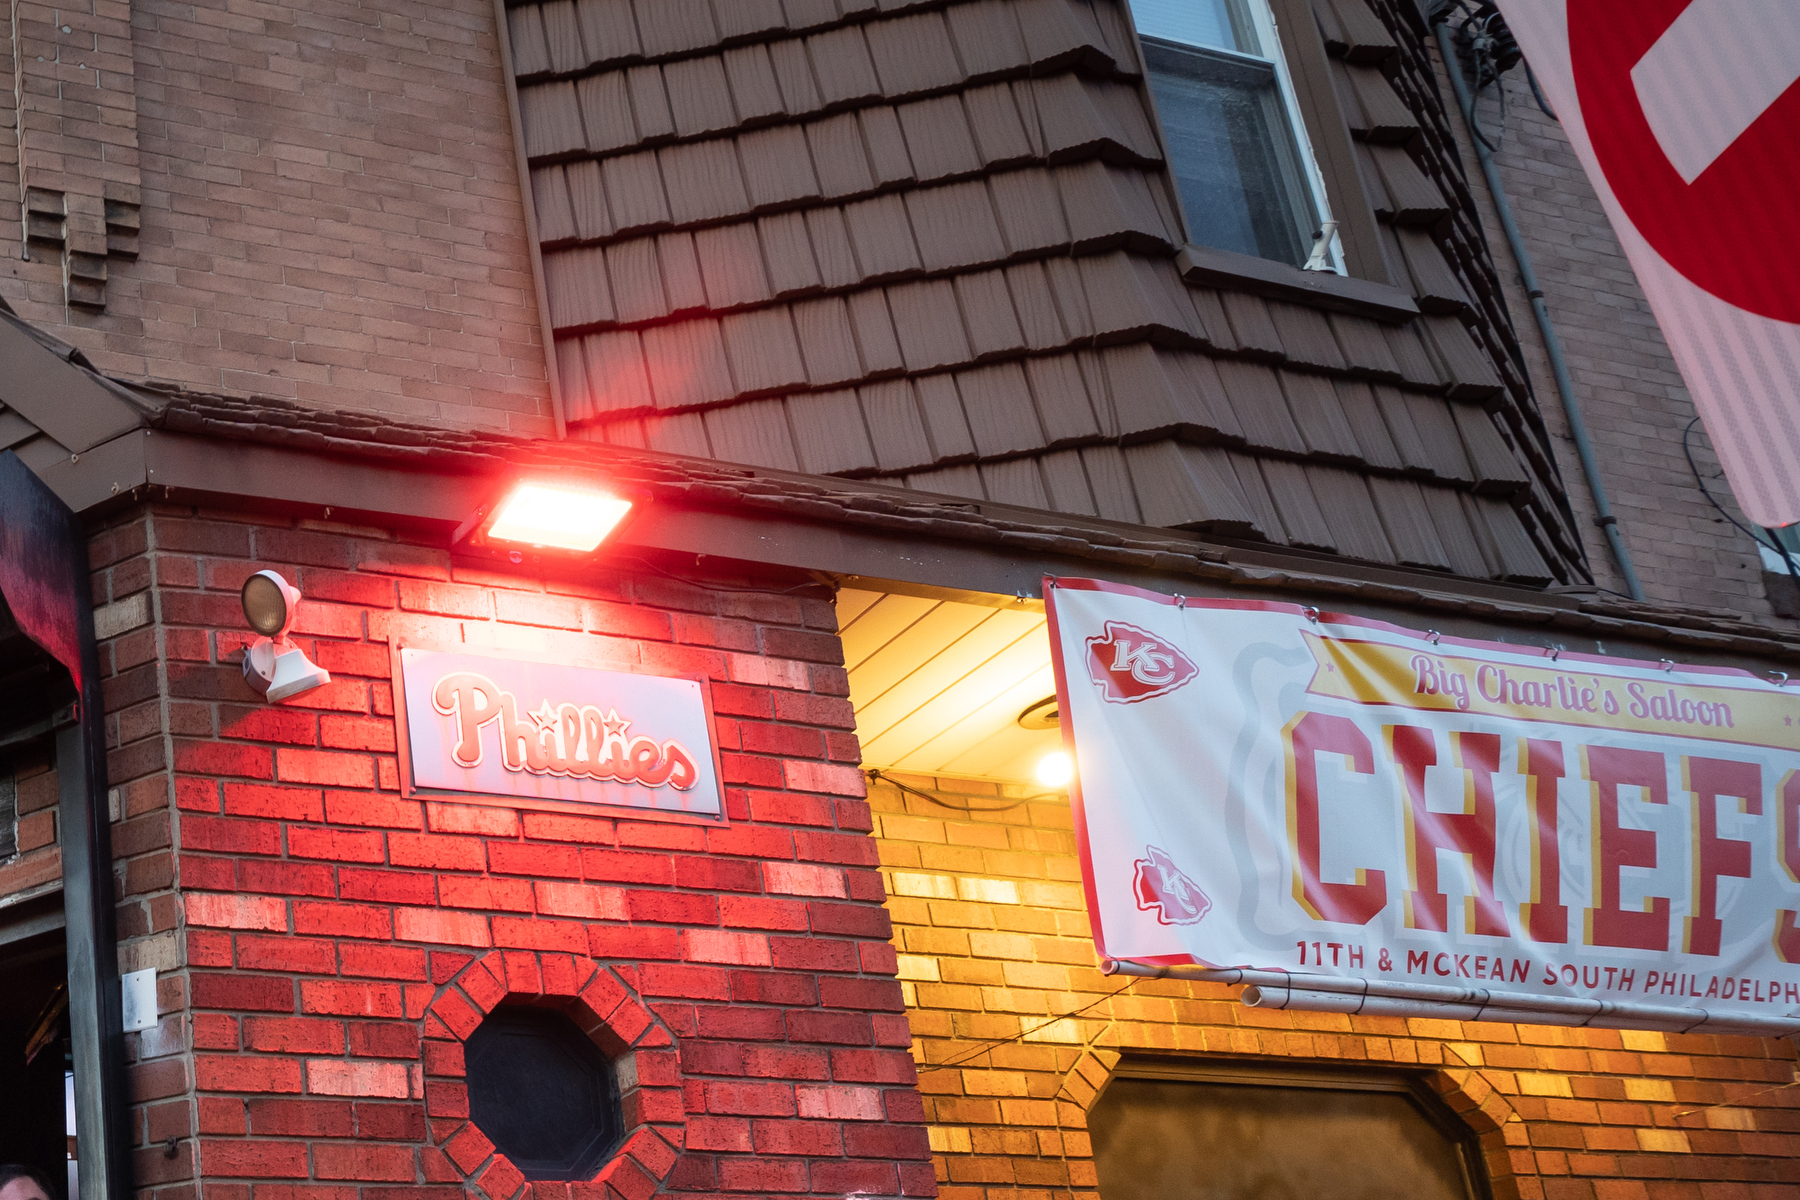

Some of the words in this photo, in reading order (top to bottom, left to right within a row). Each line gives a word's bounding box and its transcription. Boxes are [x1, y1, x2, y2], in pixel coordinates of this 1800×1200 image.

[1409, 653, 1470, 711] Big
[1475, 663, 1620, 717] Charlie's
[1624, 681, 1735, 729] Saloon
[431, 671, 699, 791] Phillies
[1296, 940, 1365, 968] 11TH
[1378, 946, 1394, 973] &
[1407, 949, 1531, 984] MCKEAN
[1543, 962, 1634, 994] SOUTH
[1643, 970, 1800, 1004] PHILADELPH
